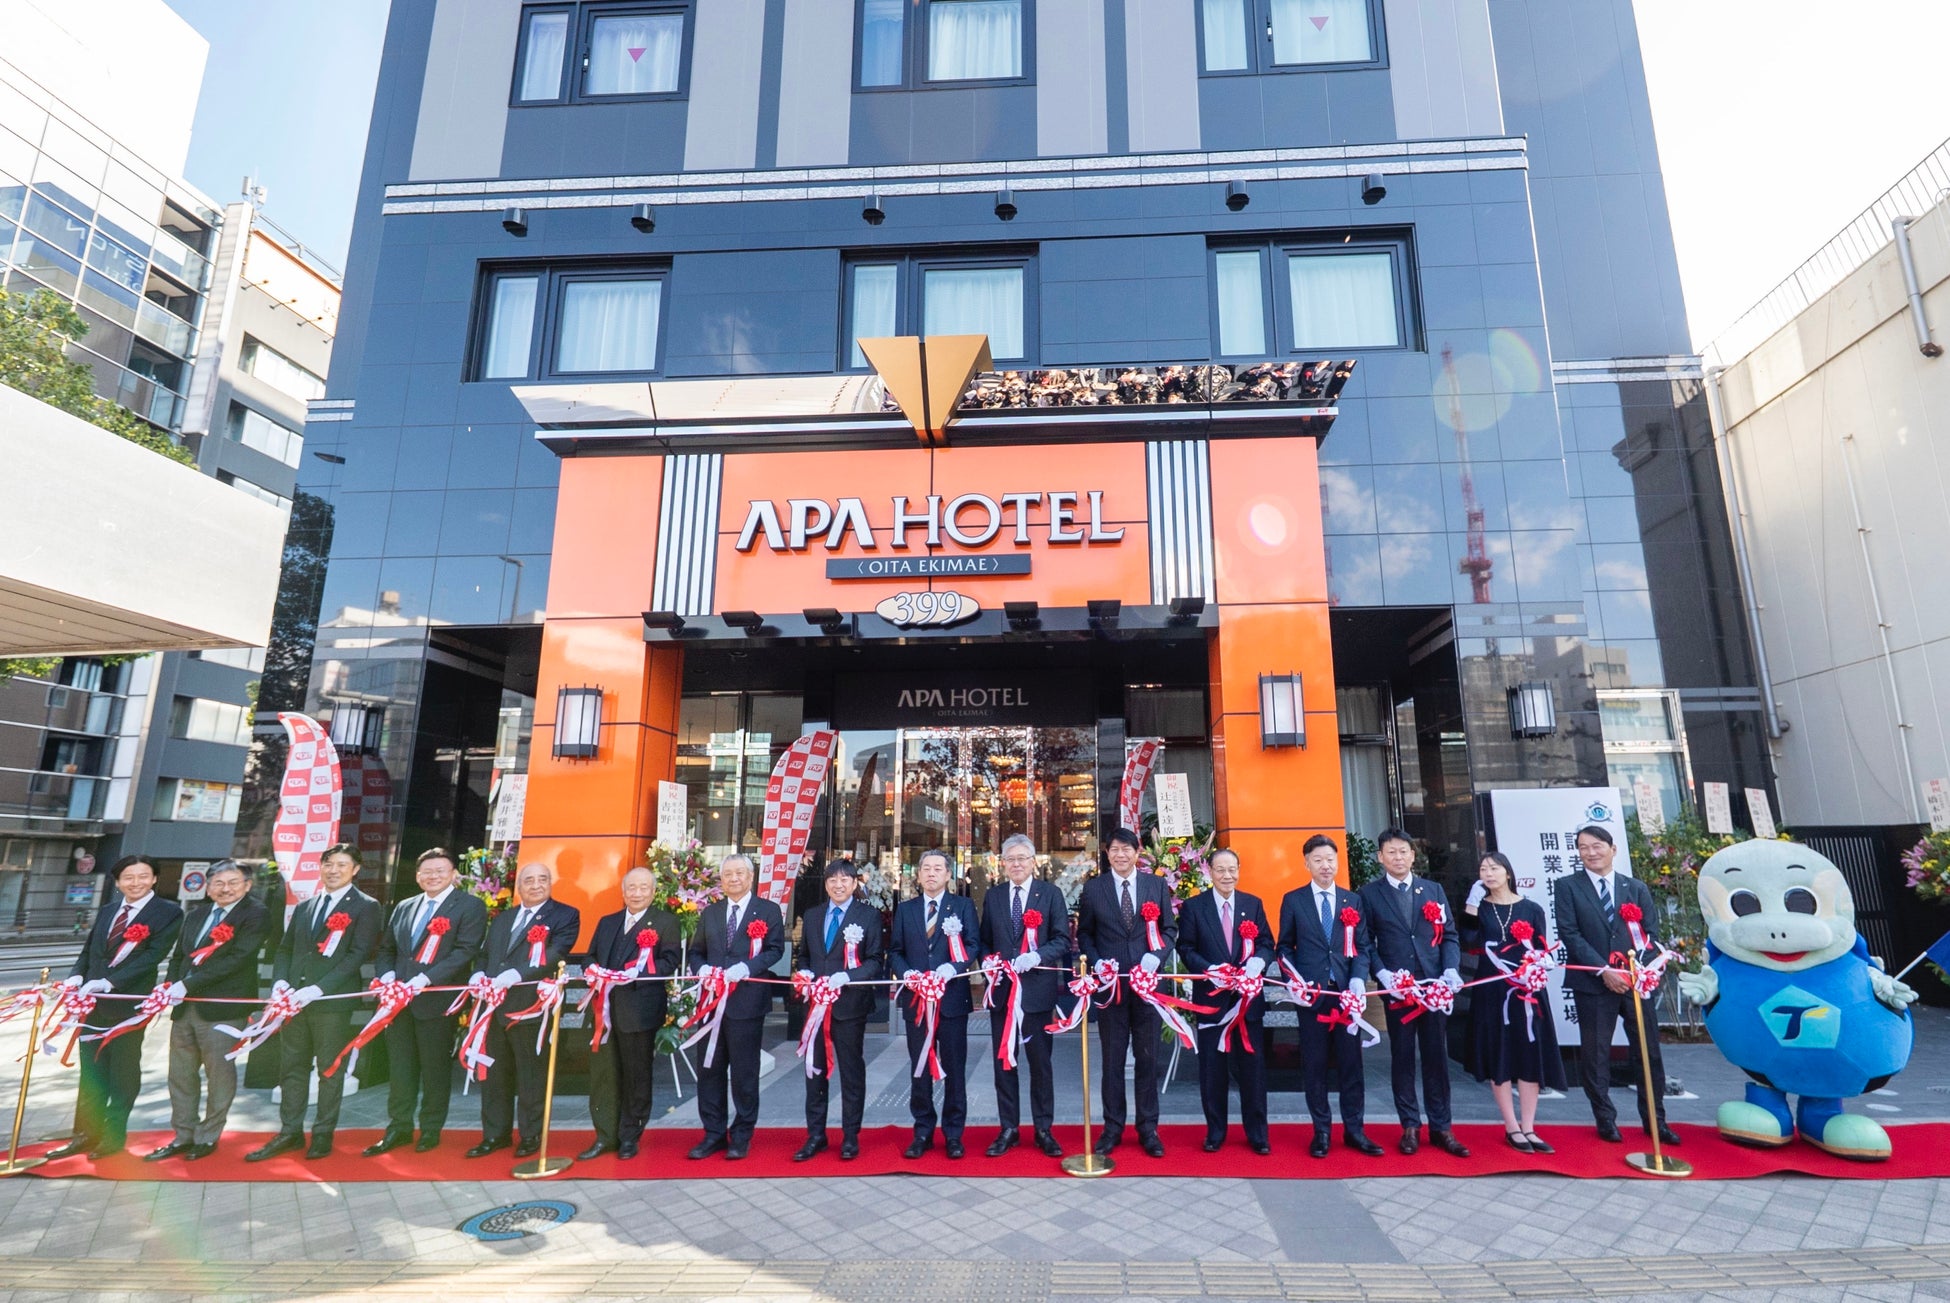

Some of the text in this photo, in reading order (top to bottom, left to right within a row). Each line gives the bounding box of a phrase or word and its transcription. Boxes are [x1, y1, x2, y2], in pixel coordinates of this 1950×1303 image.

[735, 490, 1125, 552] APA HOTEL
[892, 590, 962, 626] 399
[898, 687, 1029, 708] APA HOTEL
